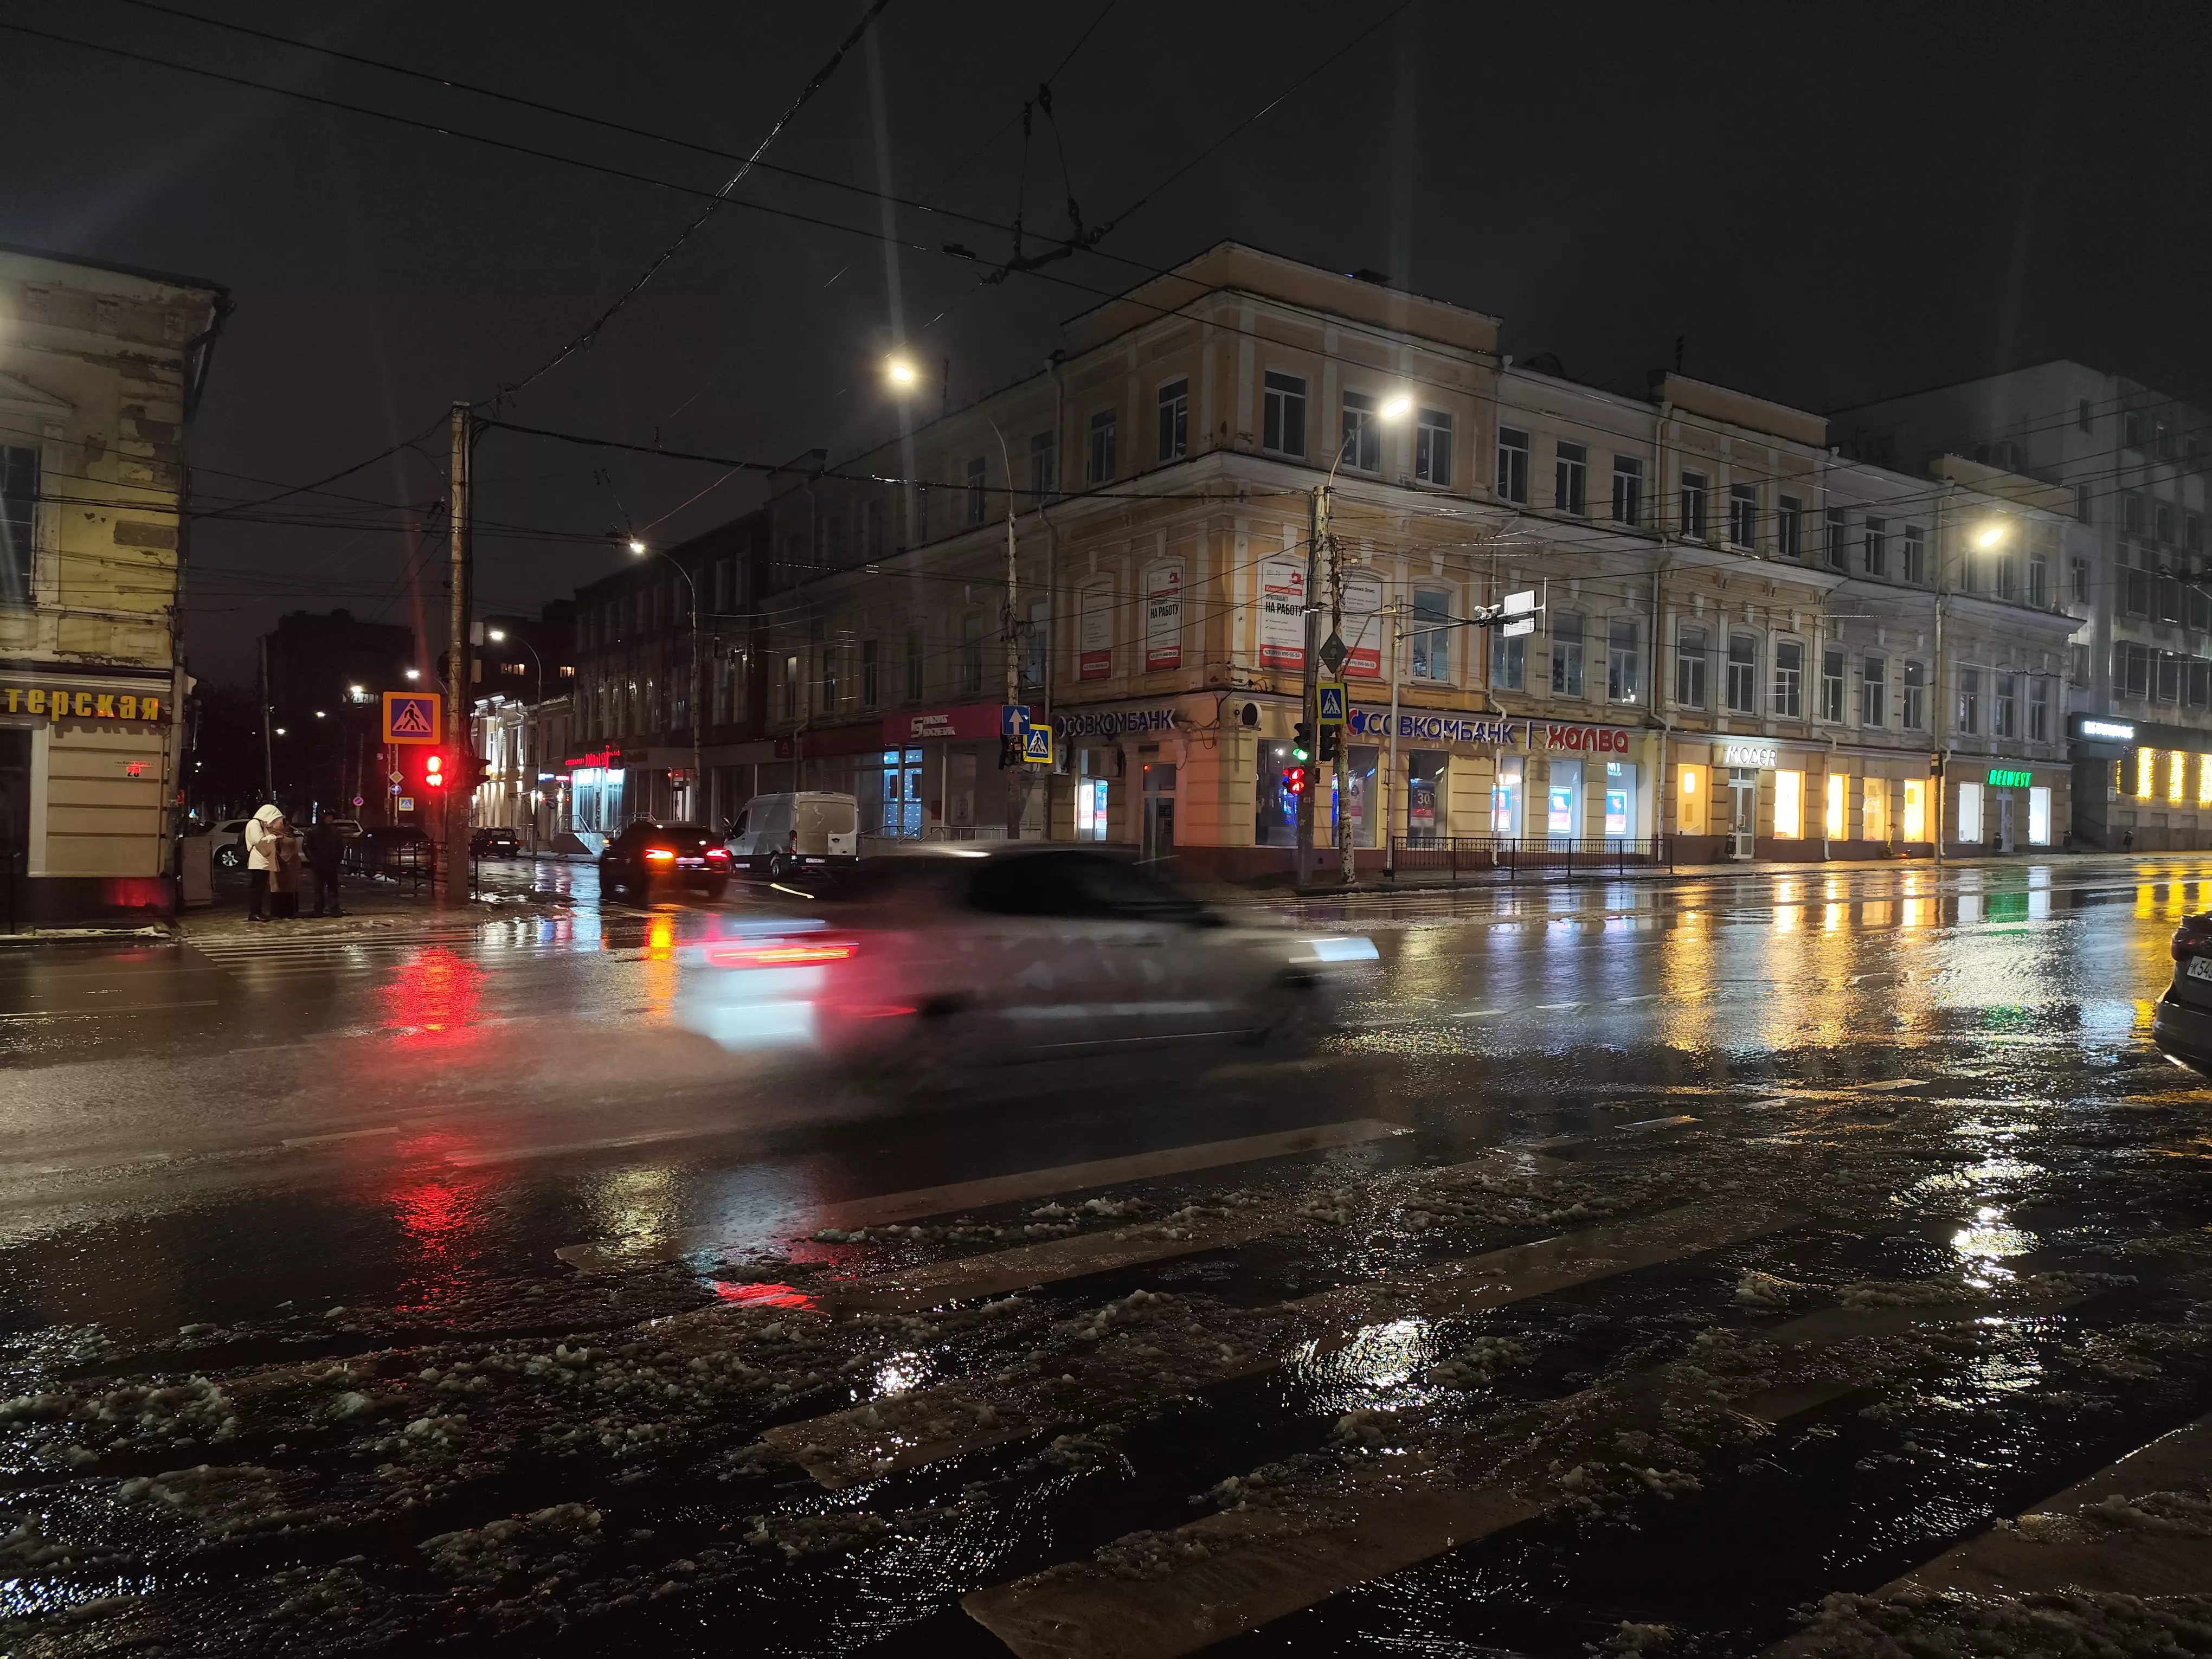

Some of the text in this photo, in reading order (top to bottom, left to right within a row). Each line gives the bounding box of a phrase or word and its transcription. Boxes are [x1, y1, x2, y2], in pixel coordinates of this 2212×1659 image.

[1150, 603, 1179, 619] НА РАБОТУ
[1266, 601, 1303, 616] НА РАБОТУ
[4, 688, 159, 722] терская
[1367, 712, 1516, 745] СОВКОМБАНК
[1987, 769, 2032, 788] BELWEST
